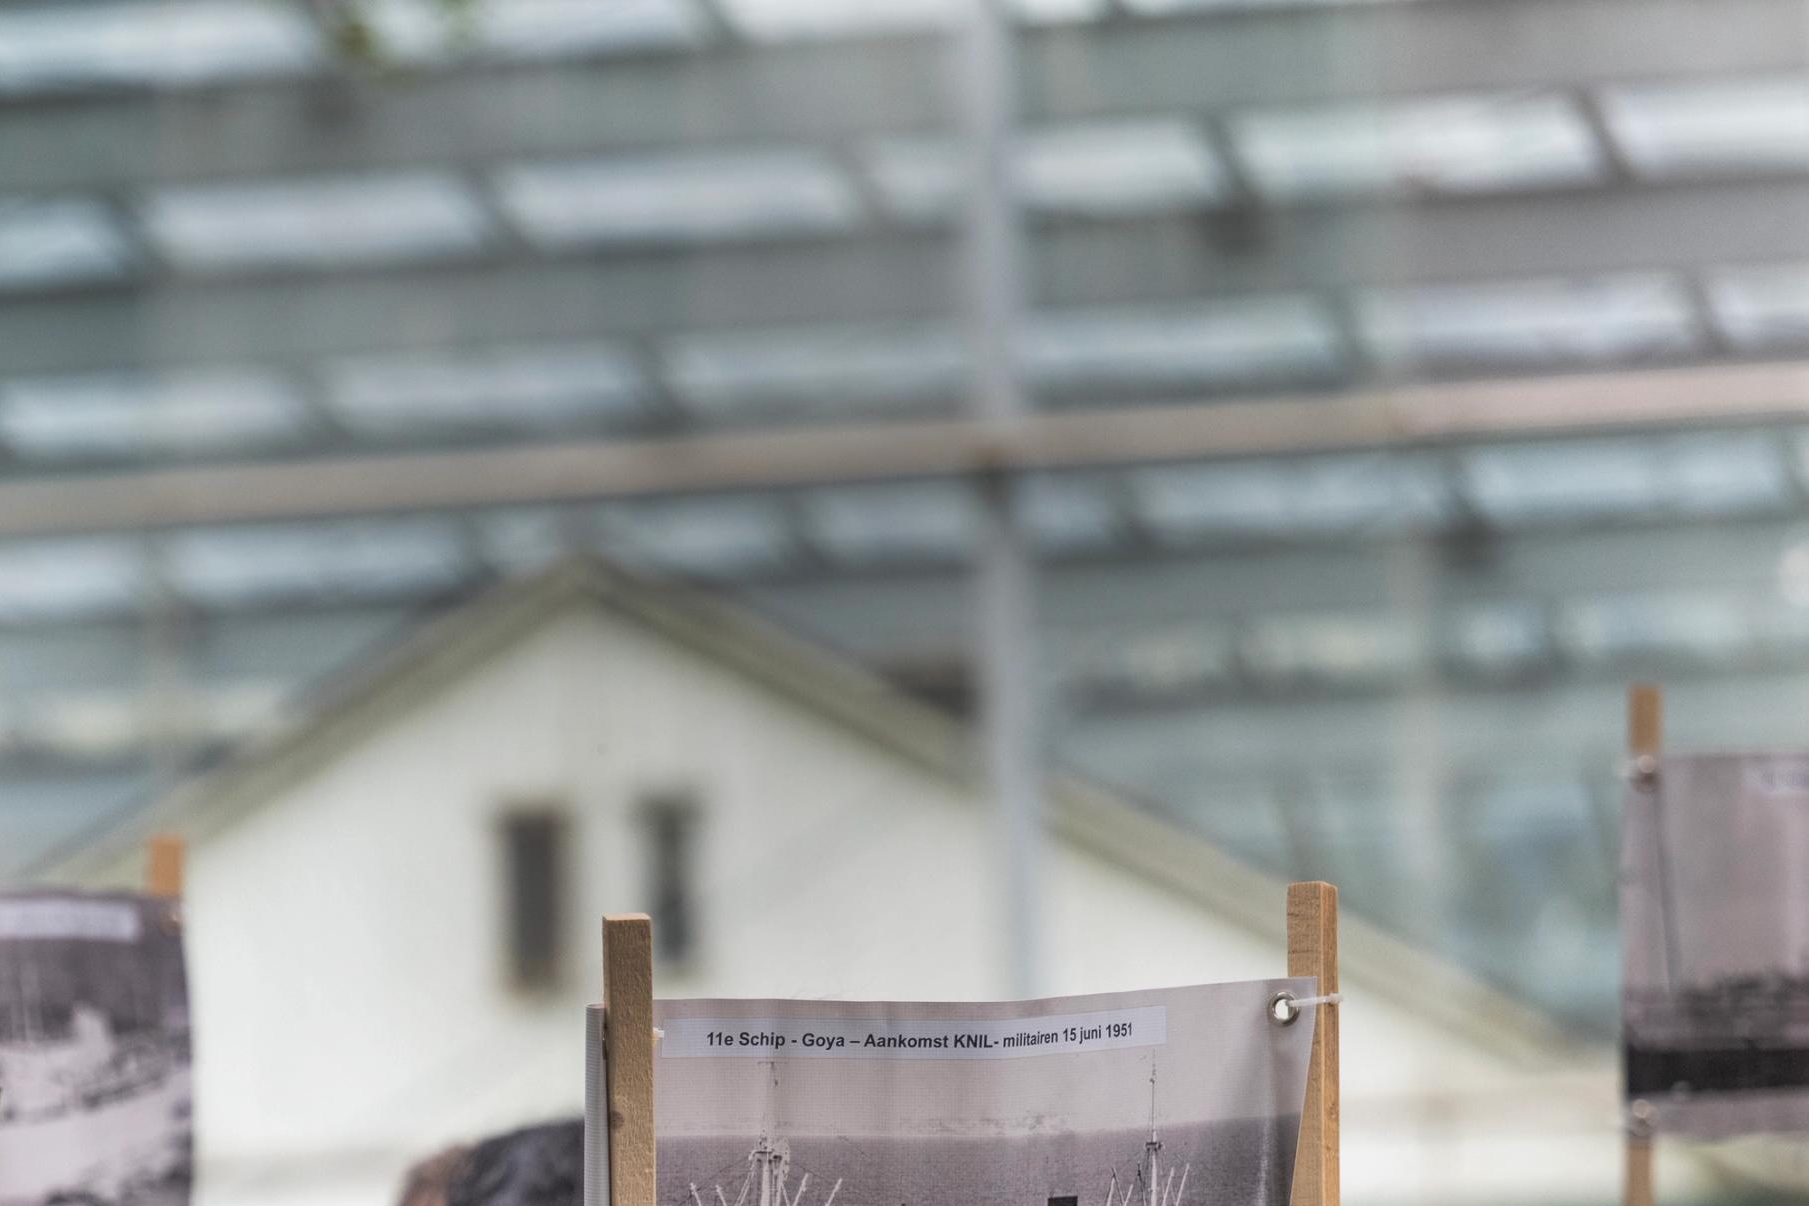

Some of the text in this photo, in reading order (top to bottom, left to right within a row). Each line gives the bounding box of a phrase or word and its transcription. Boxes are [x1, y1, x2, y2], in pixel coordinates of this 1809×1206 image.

[706, 1031, 734, 1046] 11e
[739, 1032, 785, 1049] Schip
[802, 1033, 845, 1050] Goya
[863, 1033, 948, 1048] Aankomst
[1003, 1030, 1058, 1047] militairen
[1063, 1027, 1076, 1042] 15
[1079, 1025, 1102, 1044] juni
[1105, 1022, 1133, 1038] 1951
